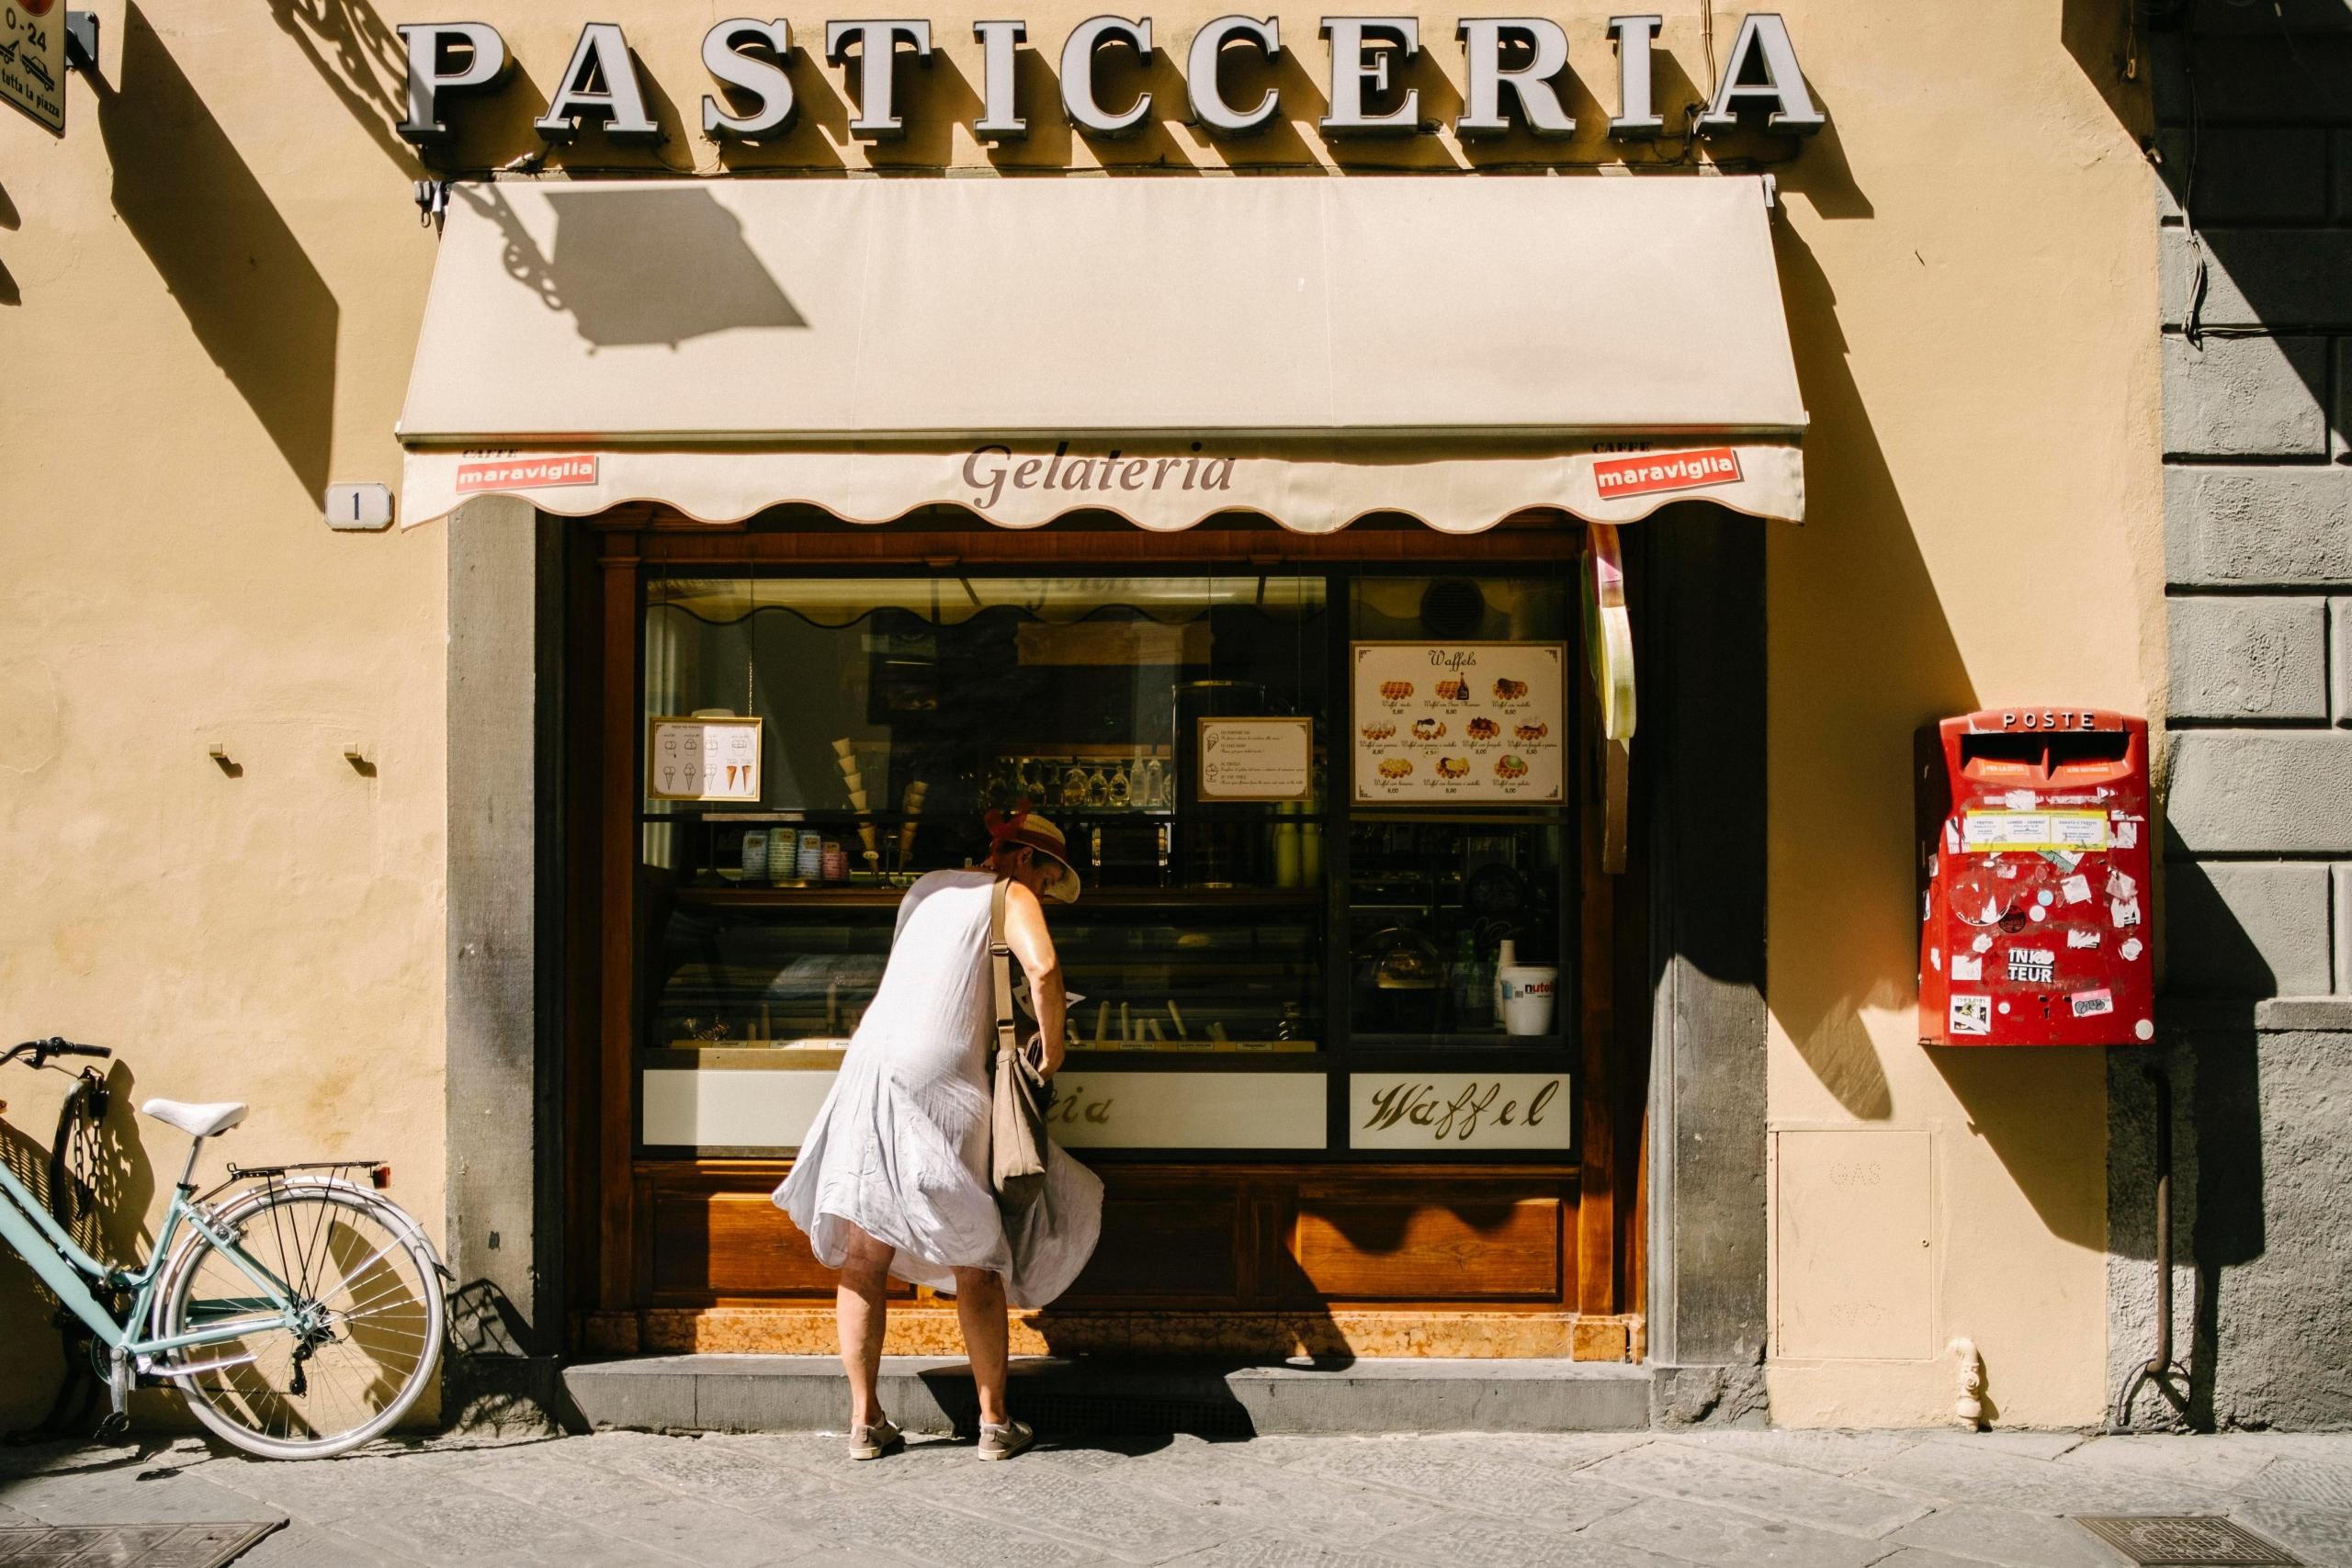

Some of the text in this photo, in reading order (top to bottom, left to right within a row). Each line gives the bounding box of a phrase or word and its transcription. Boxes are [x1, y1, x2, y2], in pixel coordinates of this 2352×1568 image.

[396, 14, 1825, 139] PASTICCERIA
[2, 68, 60, 118] tutta la piazza
[459, 461, 594, 485] maraviglia
[962, 441, 1236, 509] Gelateria
[1598, 457, 1734, 488] maraviglia
[352, 492, 359, 520] 1
[1428, 649, 1476, 671] Waffels
[2003, 711, 2095, 728] POSTE
[2008, 966, 2052, 983] TEUR
[1363, 1080, 1559, 1140] Waffel
[1829, 1161, 1881, 1186] GAS
